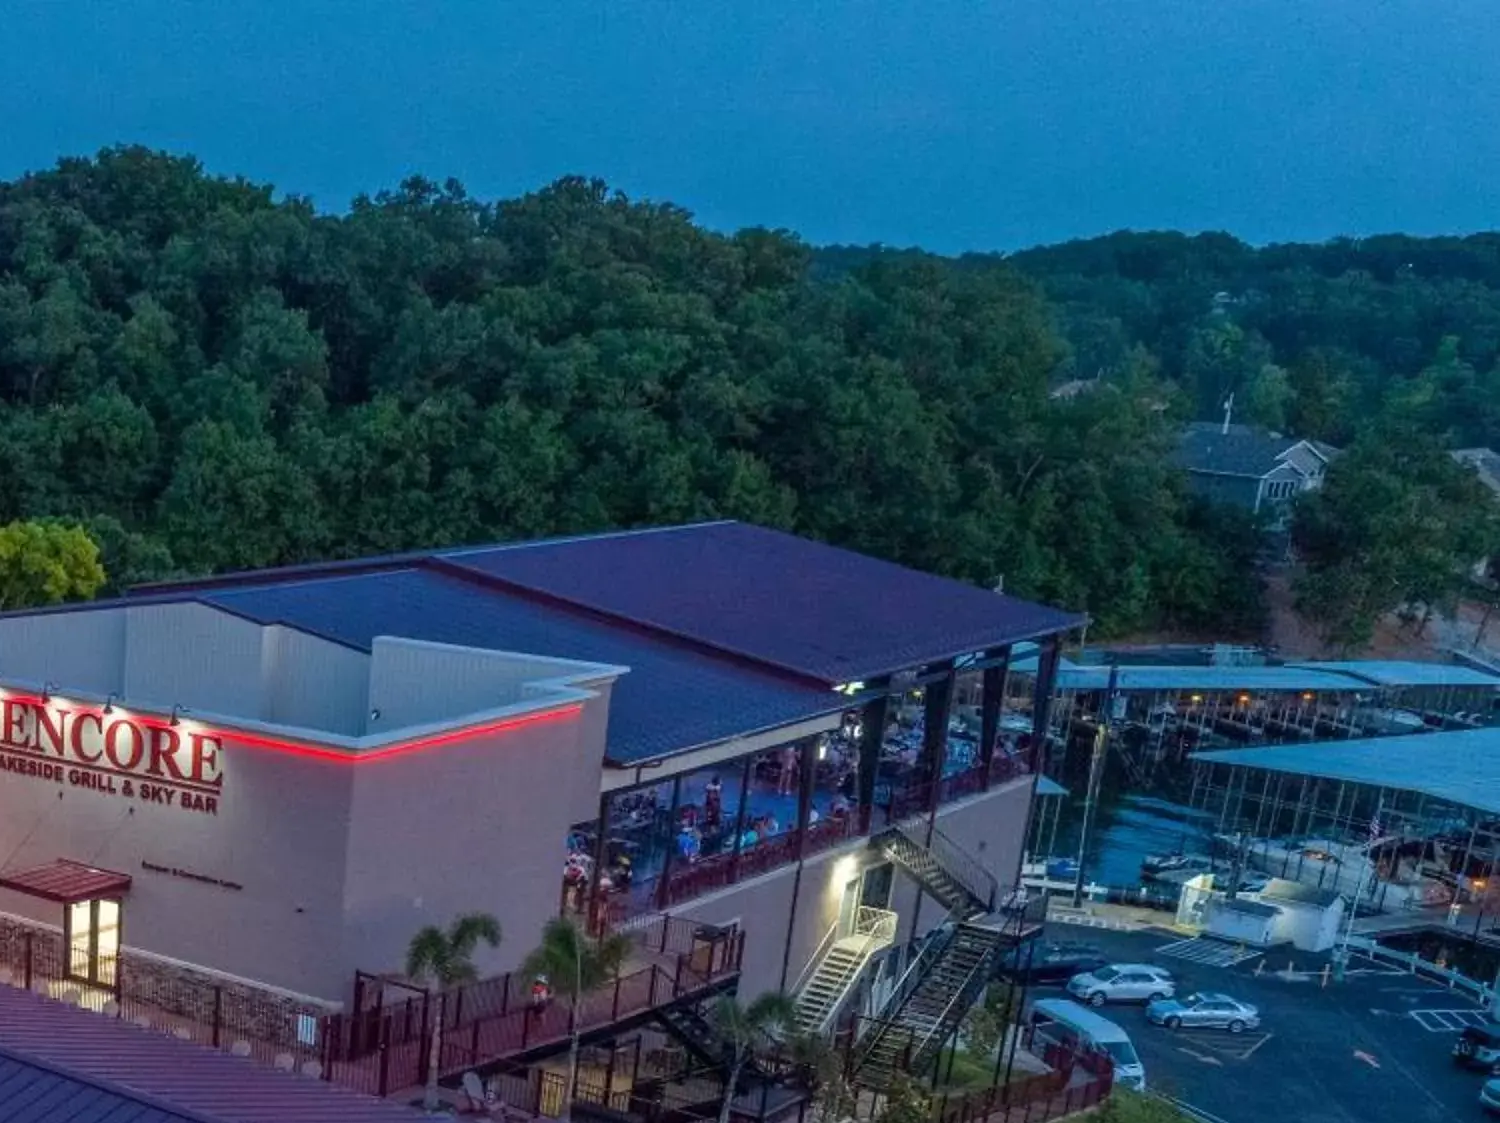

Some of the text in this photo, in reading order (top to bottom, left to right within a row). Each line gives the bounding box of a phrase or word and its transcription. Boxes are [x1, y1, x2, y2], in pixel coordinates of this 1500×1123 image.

[1, 698, 223, 787] ENCORE
[68, 770, 116, 793] GRILL
[121, 780, 135, 798] &
[140, 784, 176, 806] SKY
[180, 791, 218, 815] BAR
